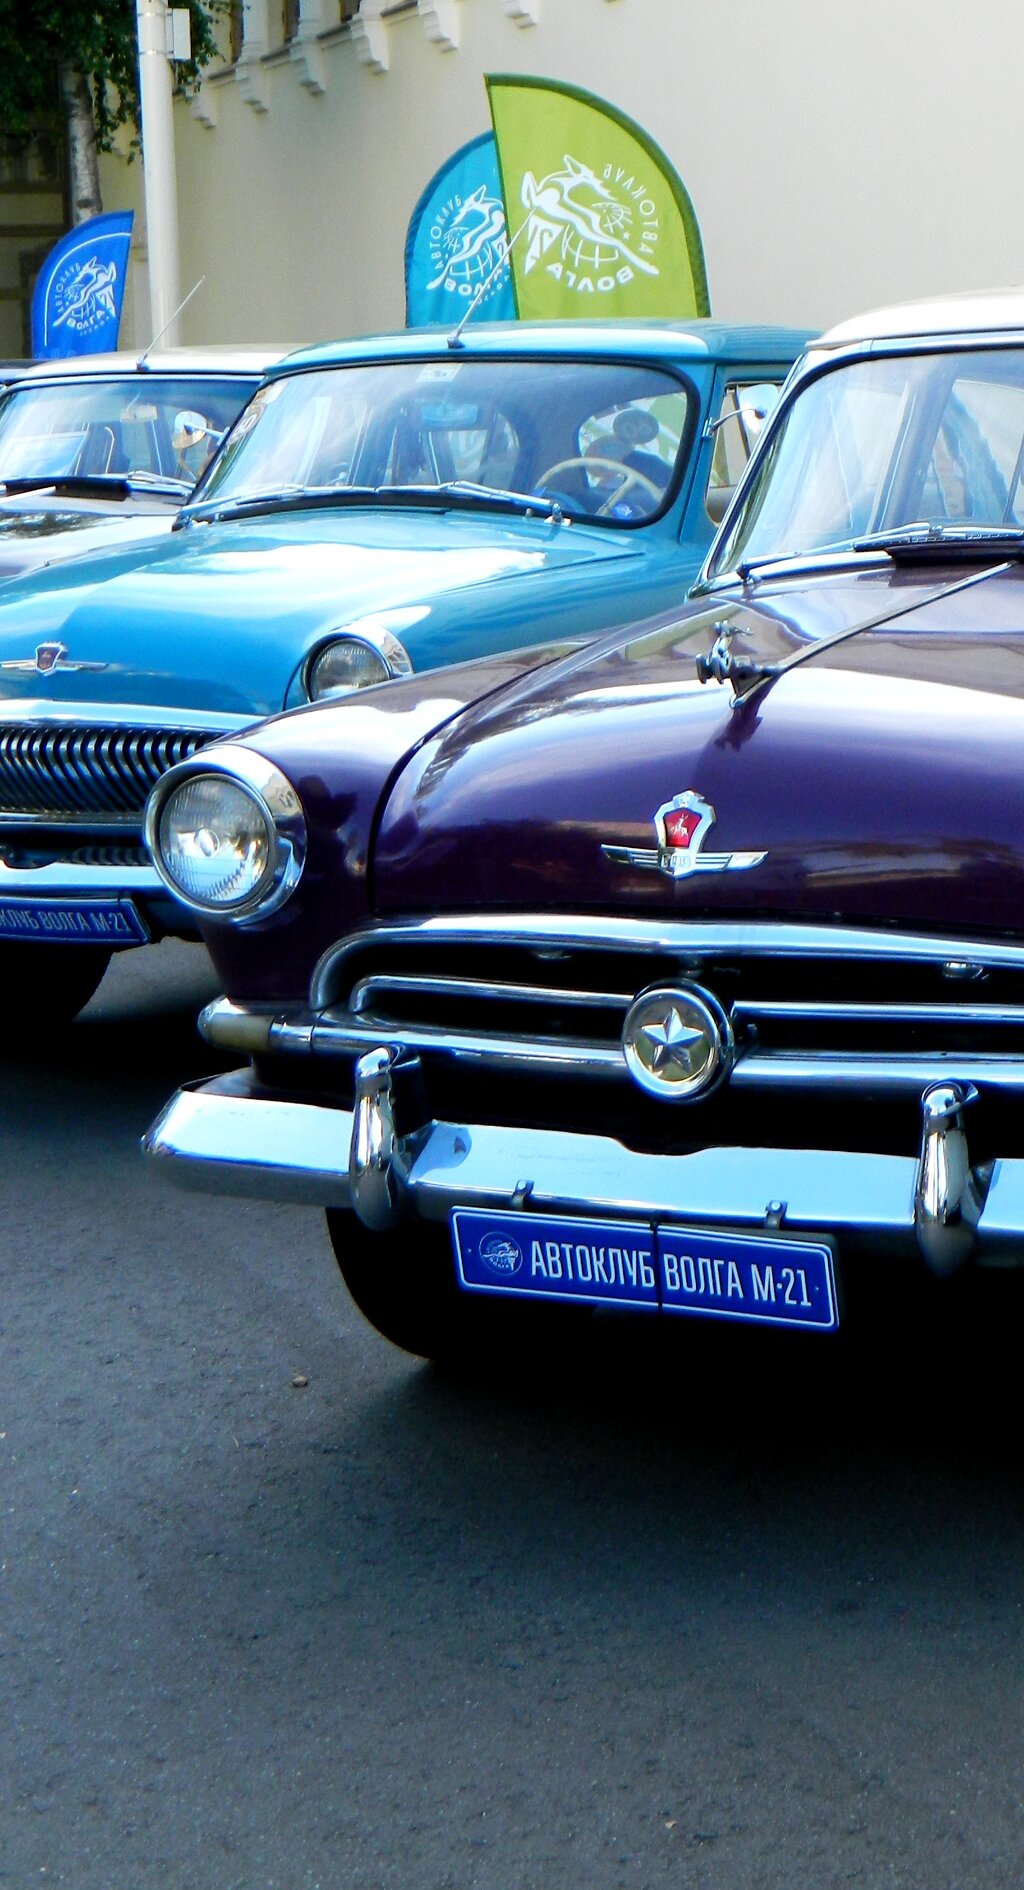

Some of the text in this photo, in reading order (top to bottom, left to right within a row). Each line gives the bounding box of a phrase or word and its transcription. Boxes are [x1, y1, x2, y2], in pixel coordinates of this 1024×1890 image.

[429, 194, 462, 270] АВТОКЛУБ
[67, 310, 105, 330] ВОЛГА
[38, 911, 91, 931] ВОЛГА
[531, 1240, 655, 1287] АВТОКЛУБ
[663, 1253, 744, 1298] ВОЛГА
